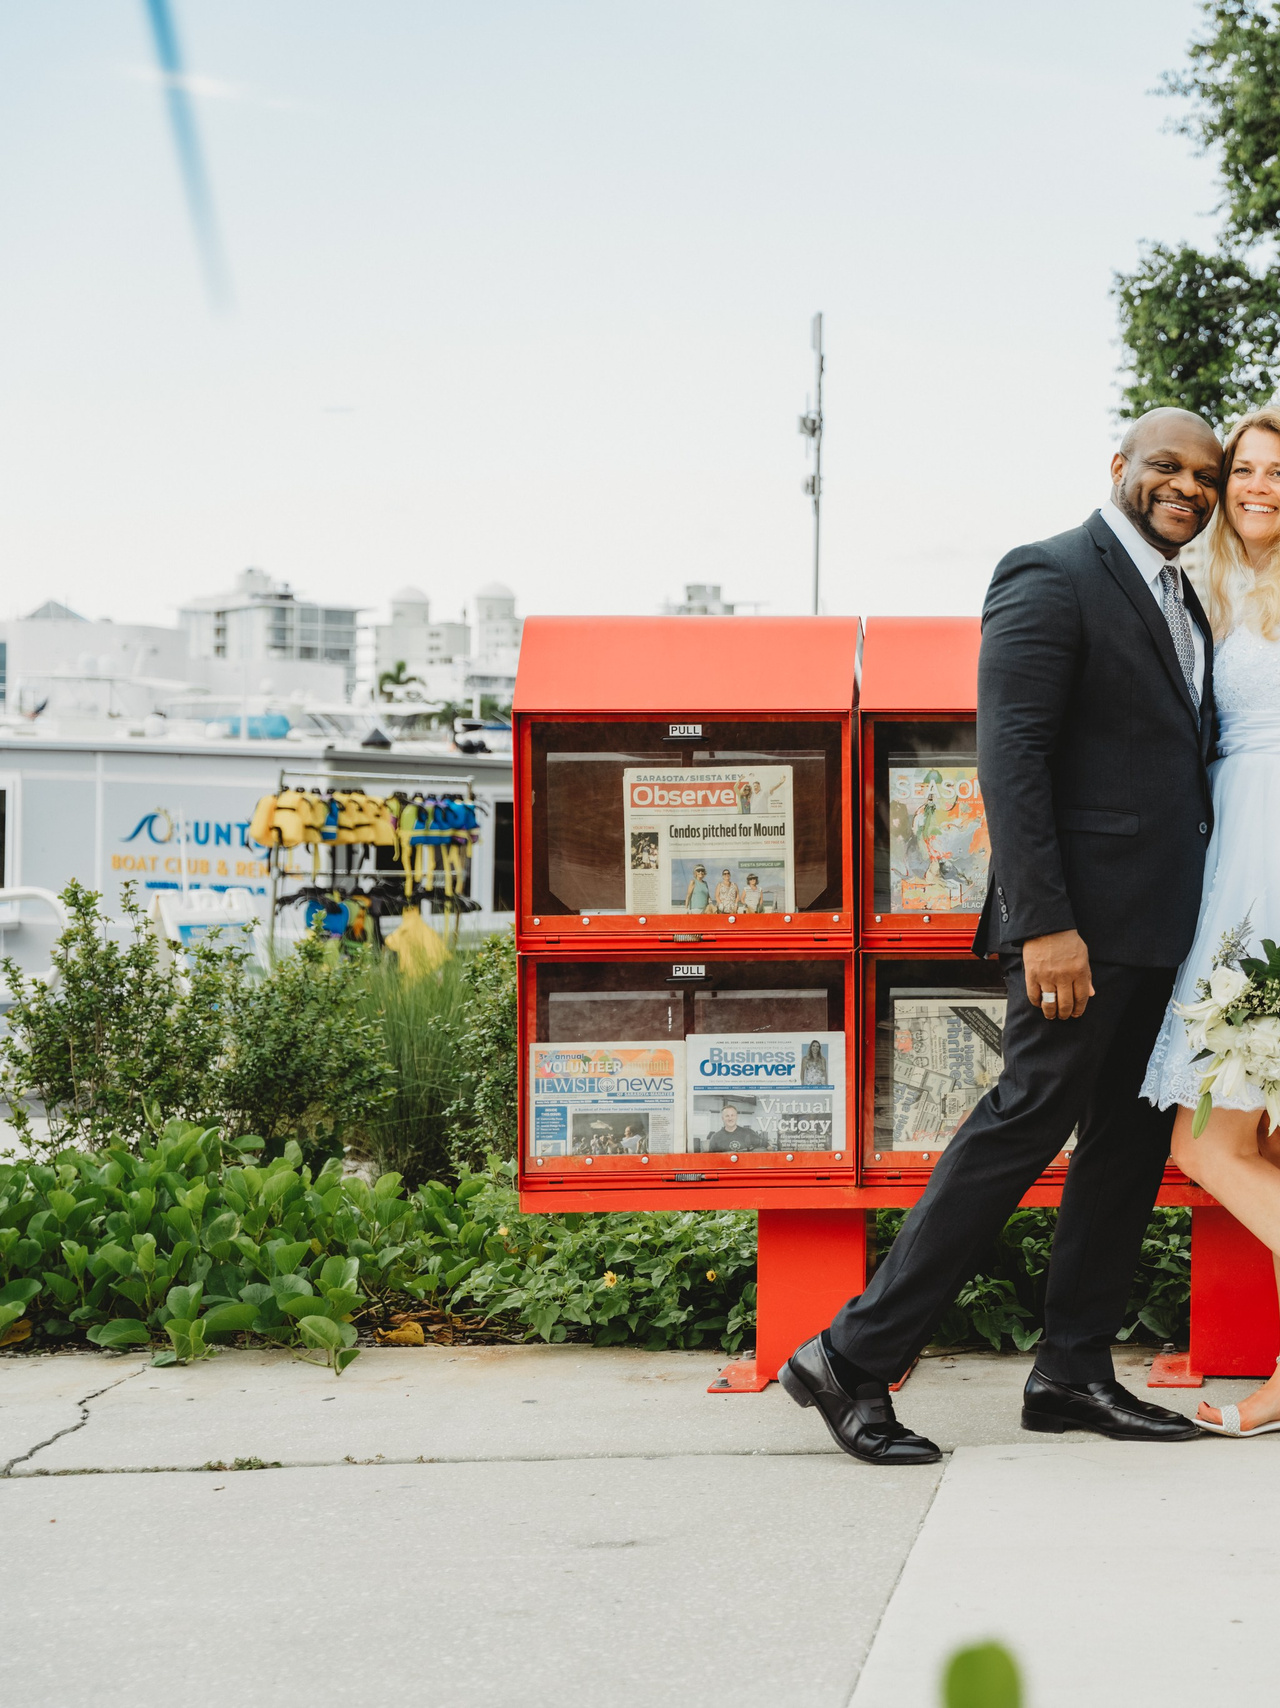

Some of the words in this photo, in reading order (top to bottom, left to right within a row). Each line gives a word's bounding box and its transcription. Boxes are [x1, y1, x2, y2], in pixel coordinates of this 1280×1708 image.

[670, 726, 700, 735] PULL
[632, 786, 738, 805] Observe
[669, 824, 700, 838] Condos
[702, 824, 737, 840] pitched
[738, 824, 752, 837] for
[754, 823, 785, 837] Mound
[111, 854, 158, 872] BOAT
[164, 857, 210, 874] CLUB
[216, 860, 228, 876] &
[236, 861, 304, 881] RENL
[674, 966, 703, 975] PULL
[964, 1025, 974, 1042] he
[710, 1048, 795, 1063] Business
[544, 1061, 622, 1073] VOLUNTEER
[700, 1059, 795, 1076] Observer
[964, 1045, 975, 1086] Happy
[538, 1078, 599, 1094] JEWISH
[617, 1078, 673, 1091] news
[760, 1098, 831, 1114] Virtual
[756, 1116, 831, 1134] Victory
